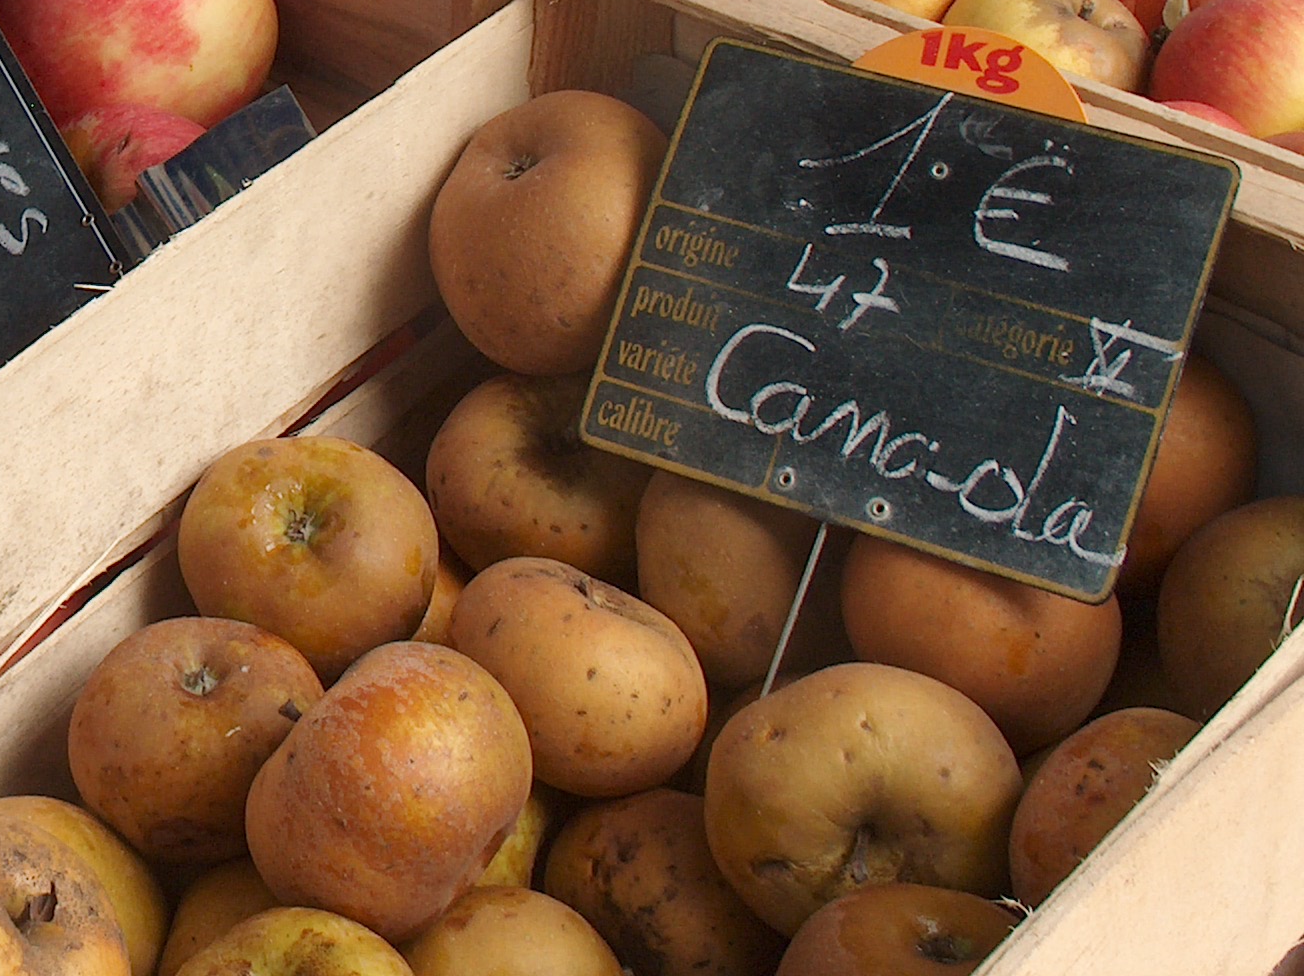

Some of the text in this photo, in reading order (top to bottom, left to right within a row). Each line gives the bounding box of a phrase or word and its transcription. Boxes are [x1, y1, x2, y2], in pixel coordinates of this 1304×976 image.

[654, 221, 901, 332] origine 47
[954, 310, 1075, 366] atégorie
[597, 396, 683, 447] calibre
